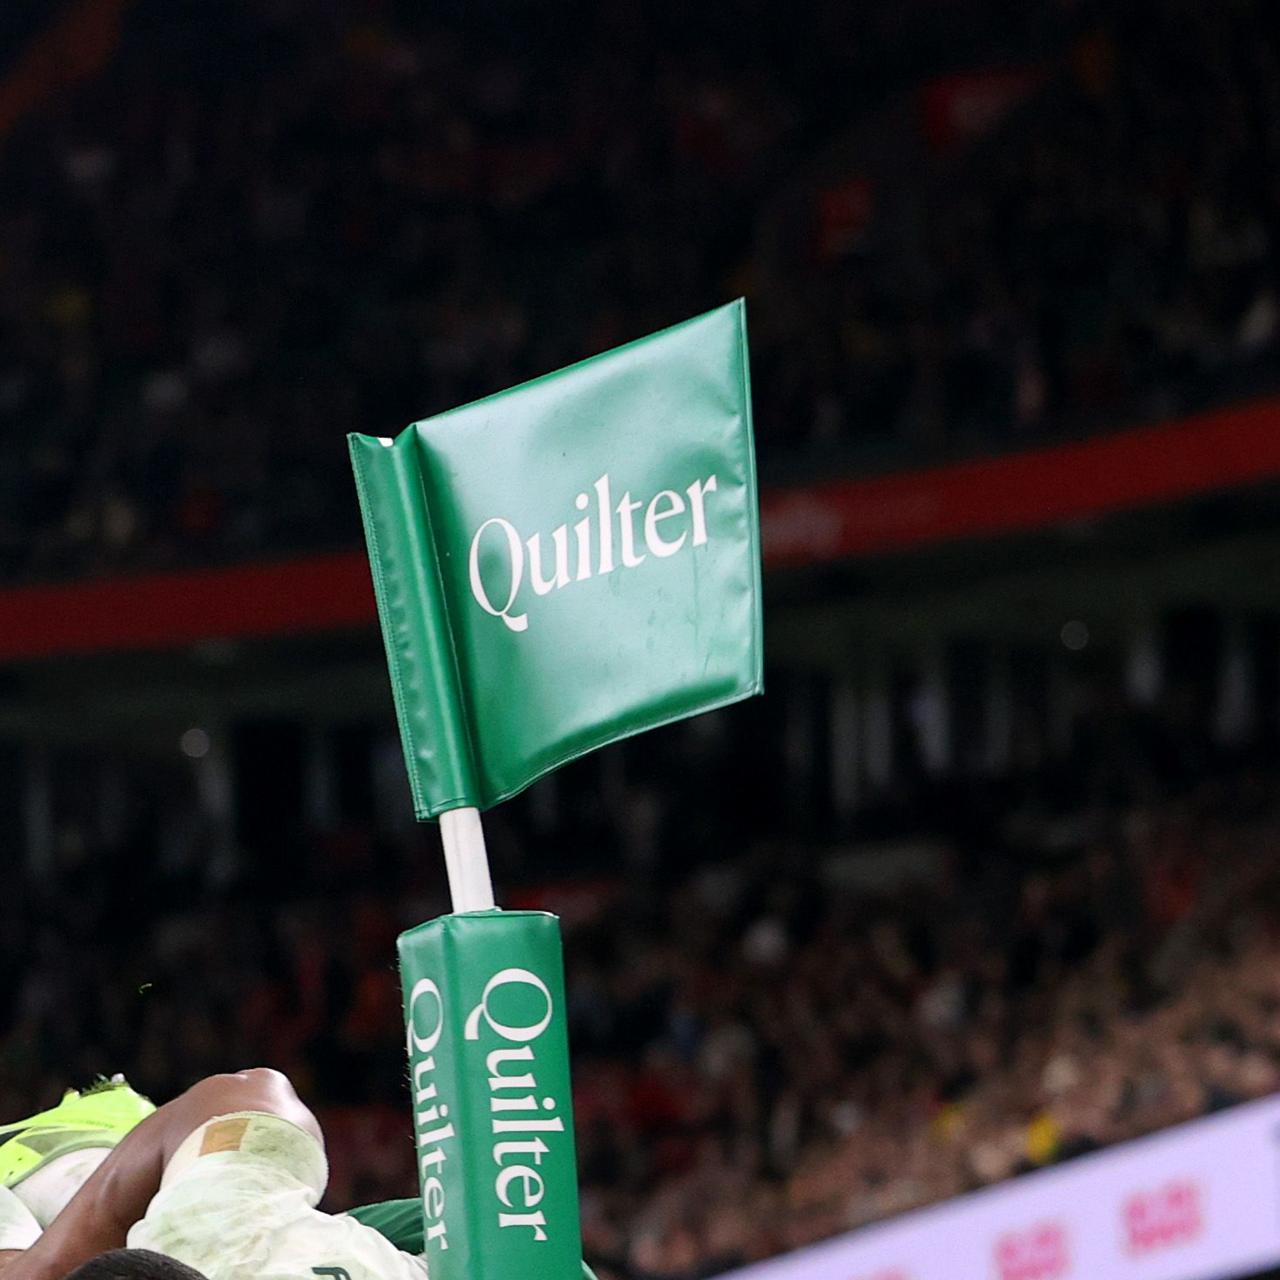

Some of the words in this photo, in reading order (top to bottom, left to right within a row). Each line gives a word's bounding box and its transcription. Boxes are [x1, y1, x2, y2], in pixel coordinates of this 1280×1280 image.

[469, 474, 717, 632] Quilter
[406, 978, 455, 1250] Quilter
[464, 967, 565, 1241] Quilter
